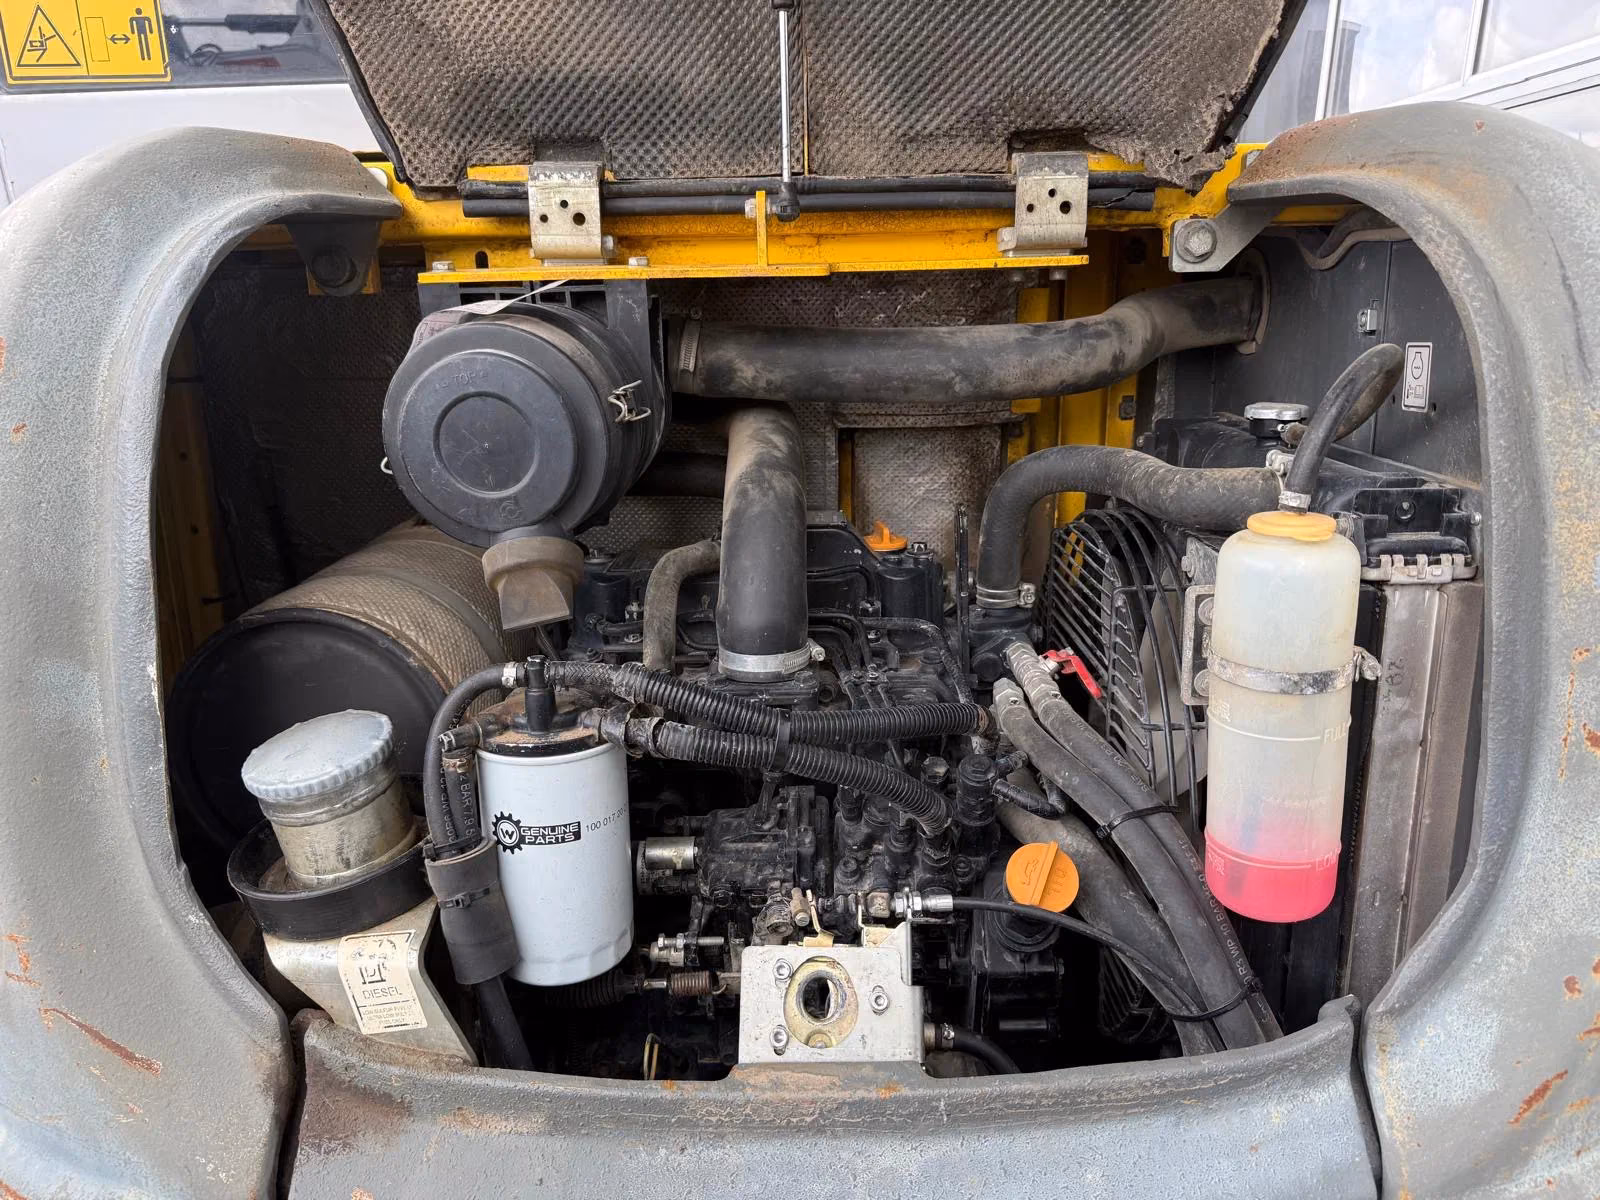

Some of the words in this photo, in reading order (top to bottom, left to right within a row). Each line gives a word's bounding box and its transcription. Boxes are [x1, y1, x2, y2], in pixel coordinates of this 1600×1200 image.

[461, 783, 472, 808] BAR
[520, 822, 579, 836] GENUINE
[585, 820, 602, 832] 100
[602, 811, 616, 827] 017
[525, 832, 575, 845] PARTS
[1209, 898, 1225, 922] BAR
[1220, 923, 1232, 937] 10
[1226, 938, 1240, 958] WP
[1235, 958, 1248, 976] R3
[362, 985, 403, 1000] DIESEL
